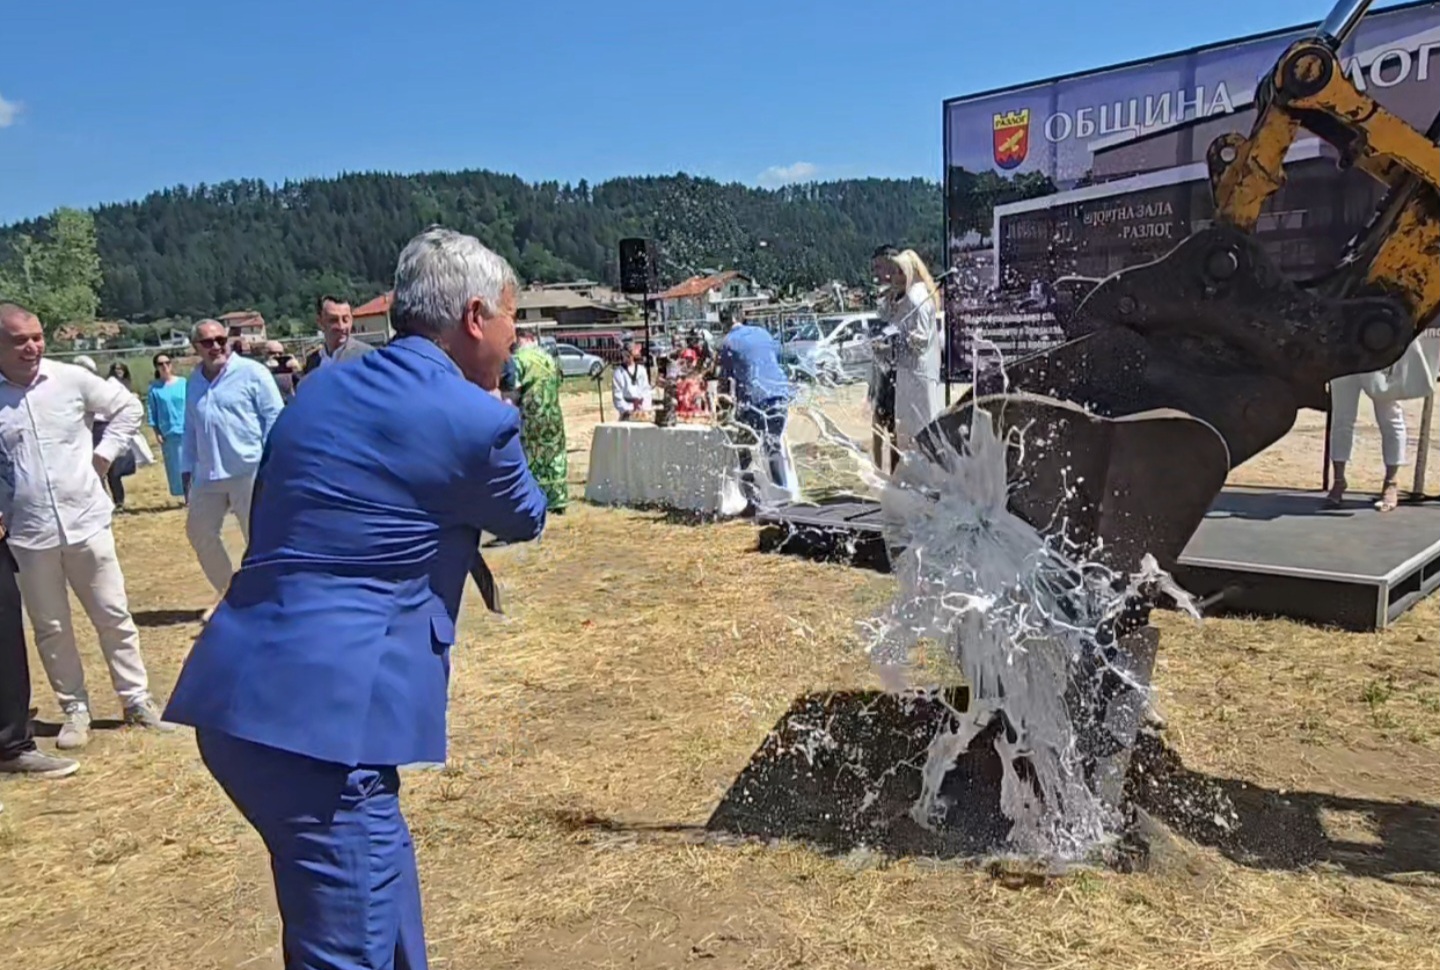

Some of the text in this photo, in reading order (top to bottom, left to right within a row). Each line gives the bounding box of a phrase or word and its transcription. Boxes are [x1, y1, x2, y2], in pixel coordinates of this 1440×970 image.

[1044, 41, 1440, 143] ОБЩИНА ЛОГ
[1136, 201, 1173, 217] ЗАЛА
[1123, 221, 1173, 238] РАЗЛОГ
